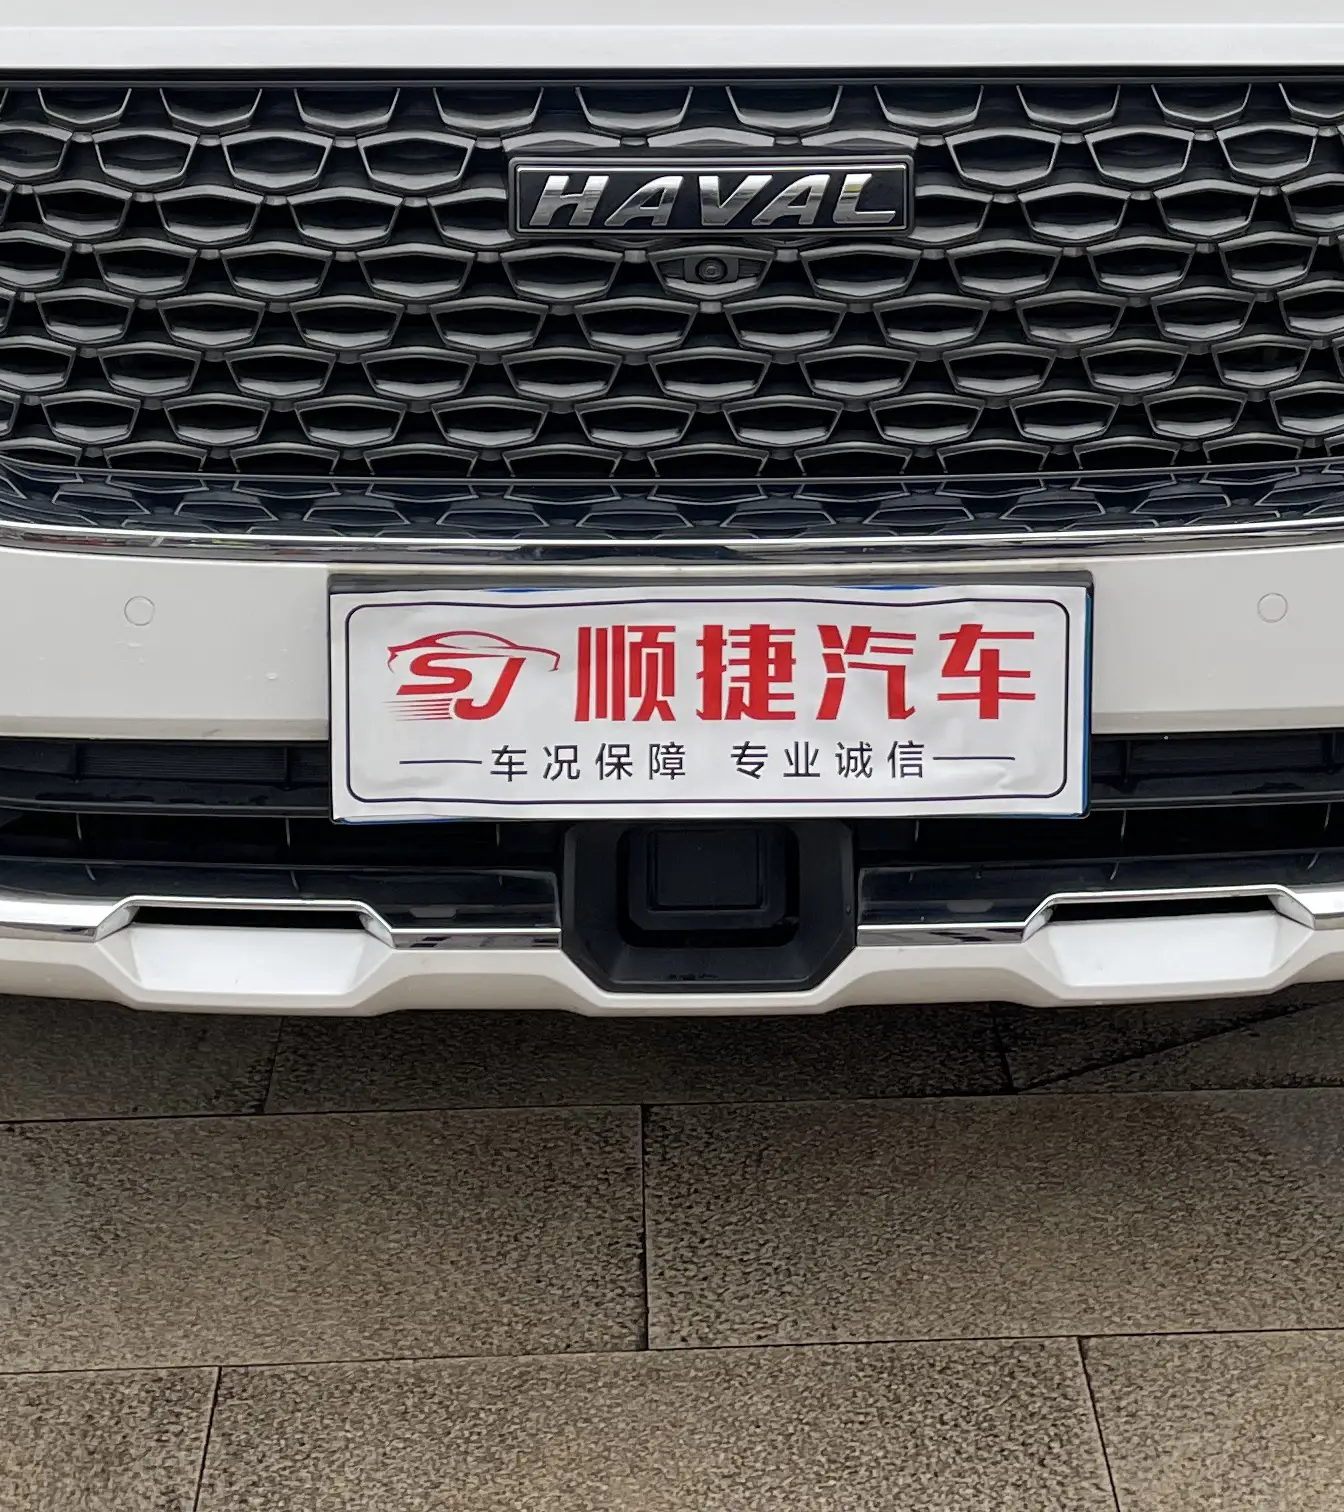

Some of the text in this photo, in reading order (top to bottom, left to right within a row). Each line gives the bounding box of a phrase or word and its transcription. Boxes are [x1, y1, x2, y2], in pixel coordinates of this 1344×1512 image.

[529, 172, 899, 227] HAVAL
[574, 622, 1037, 722] 顺捷汽车
[488, 739, 926, 782] 车况保障 专业诚信
